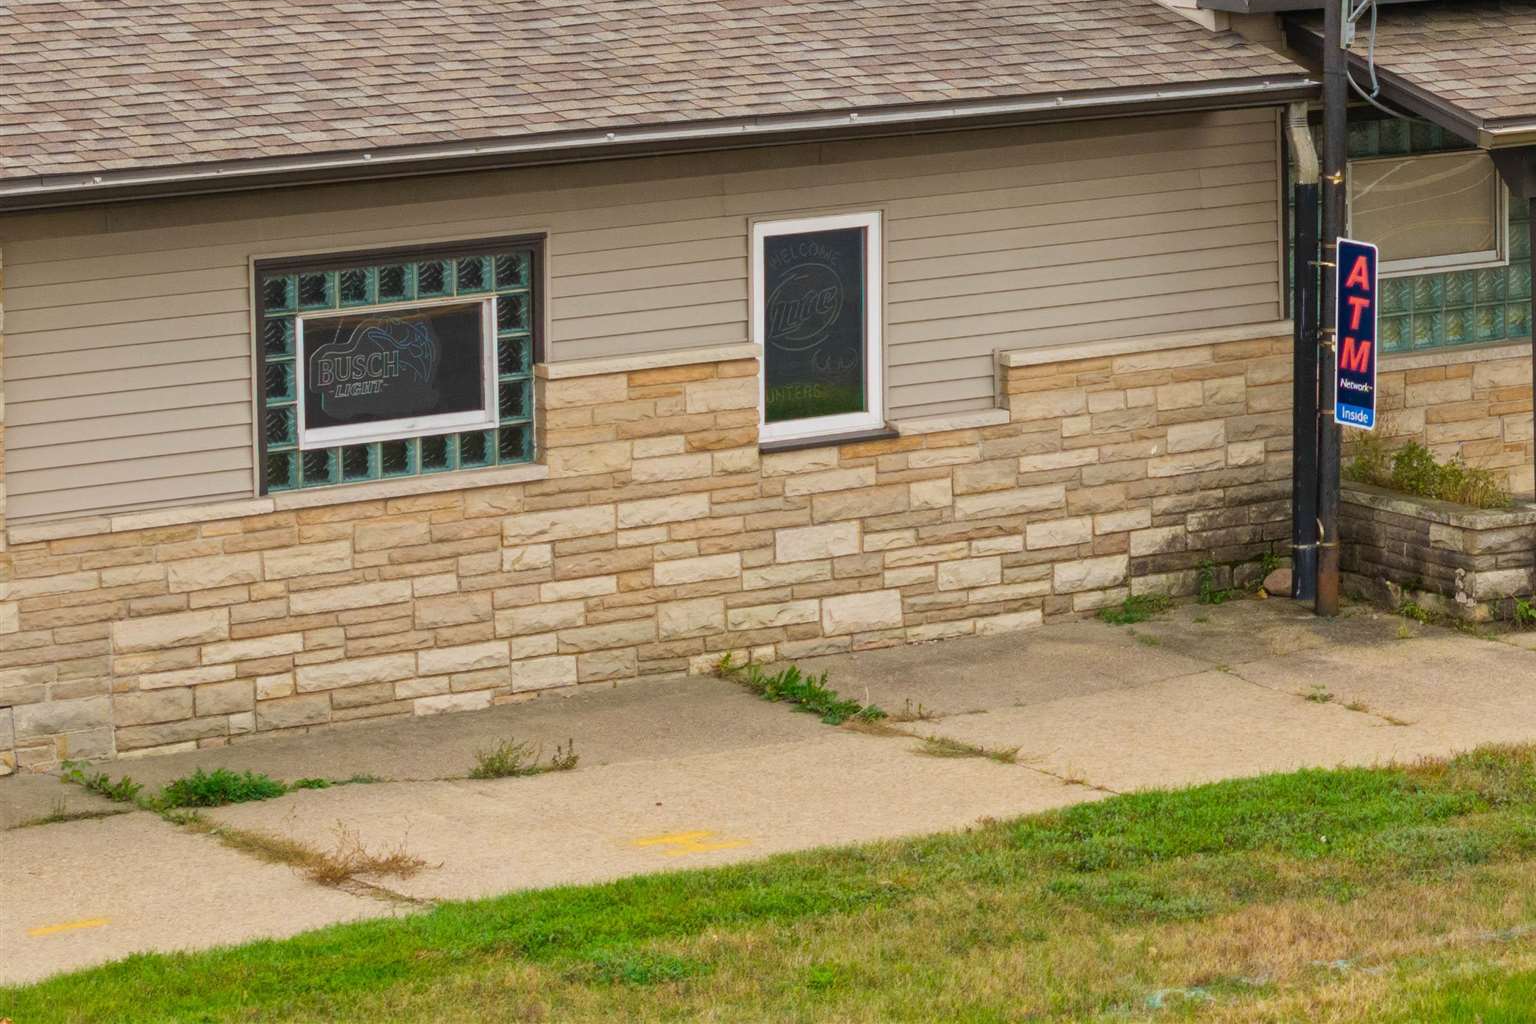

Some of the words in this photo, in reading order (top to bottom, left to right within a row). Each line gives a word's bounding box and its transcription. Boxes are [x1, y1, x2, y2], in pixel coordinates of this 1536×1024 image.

[769, 241, 841, 269] WELCOME
[1339, 255, 1372, 373] ATM
[317, 350, 400, 387] BUSCH
[1341, 405, 1370, 424] Inside
